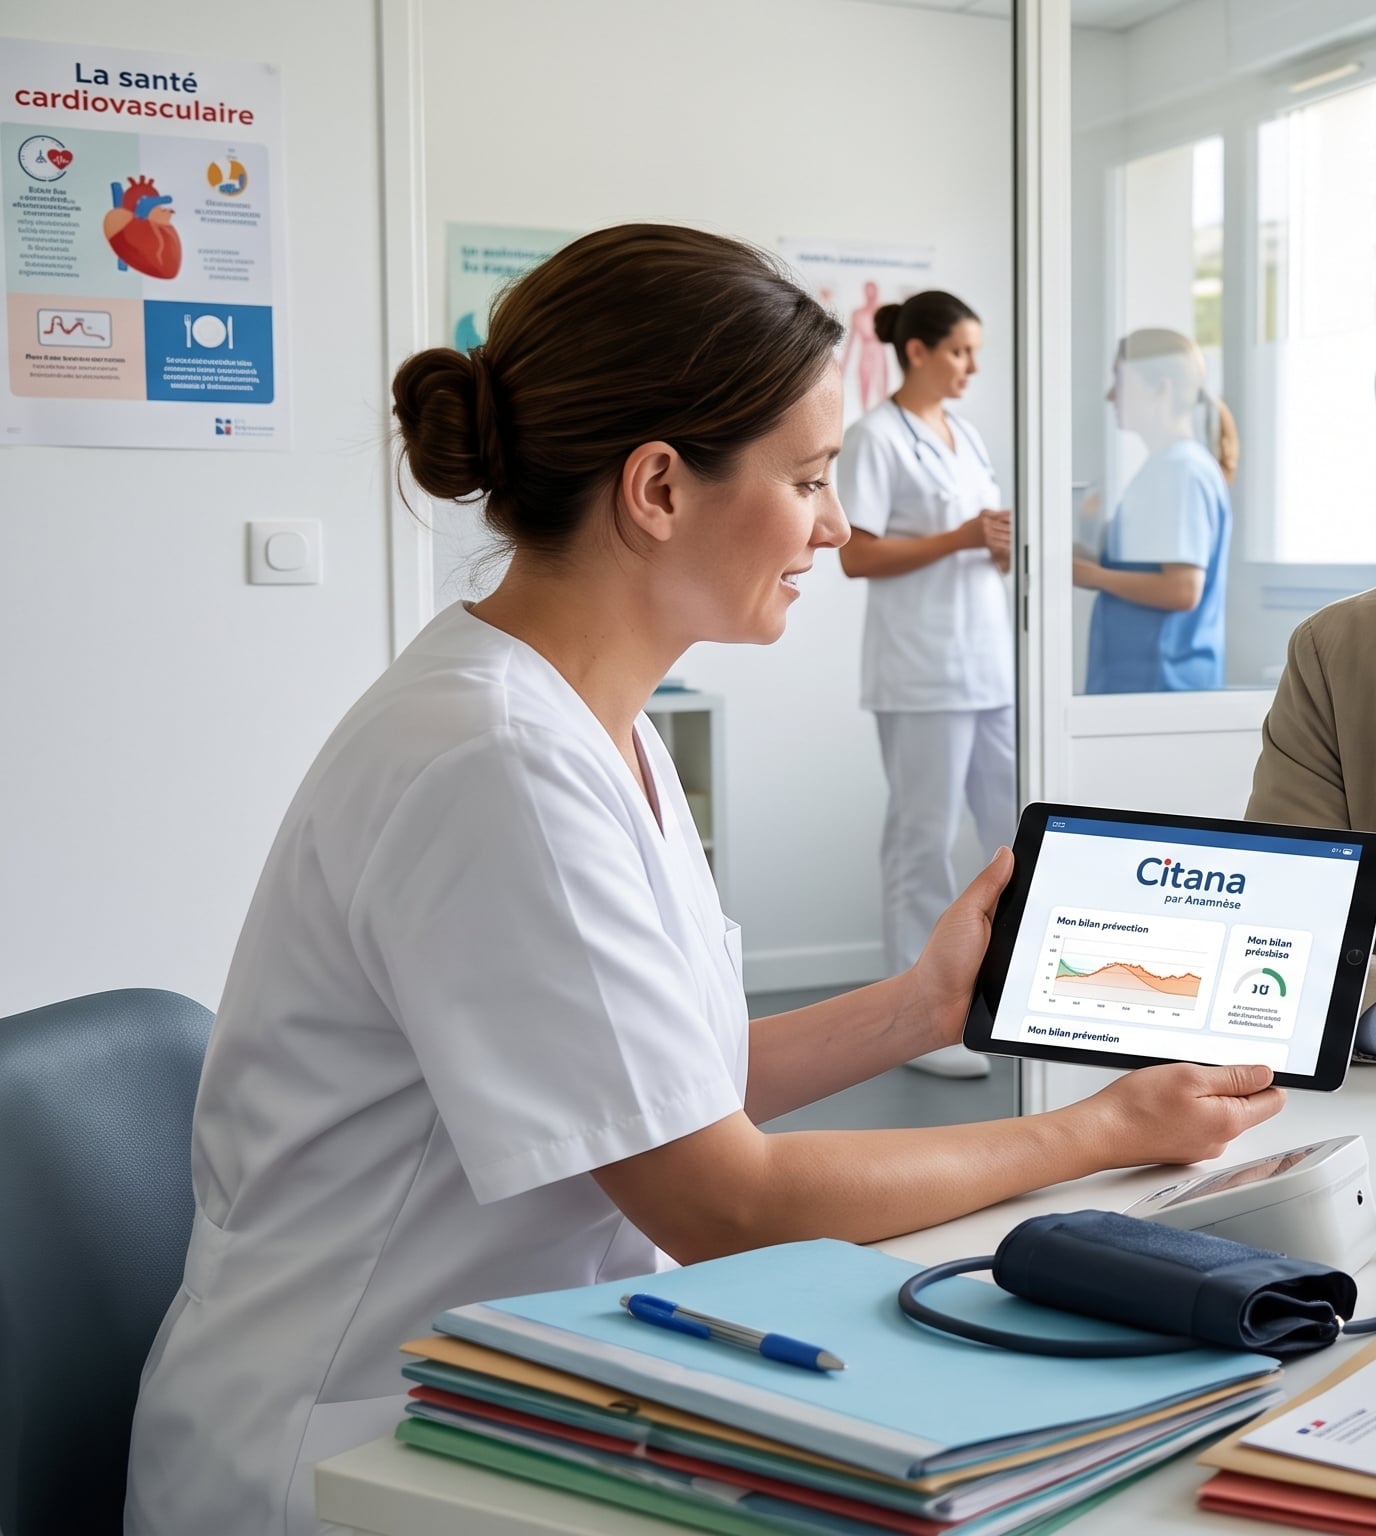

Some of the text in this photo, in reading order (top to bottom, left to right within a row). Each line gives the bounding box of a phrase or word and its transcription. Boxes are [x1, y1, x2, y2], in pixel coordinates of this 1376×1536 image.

[75, 62, 198, 93] La santé
[14, 89, 255, 126] cardiovasculaire
[1136, 857, 1246, 895] Citana
[1164, 895, 1241, 910] par Anamnèse
[1056, 916, 1077, 926] Mon
[1078, 918, 1101, 929] bilan
[1247, 935, 1293, 948] Mon bilan
[1027, 1025, 1047, 1035] Mon
[1071, 1030, 1120, 1043] prévention
